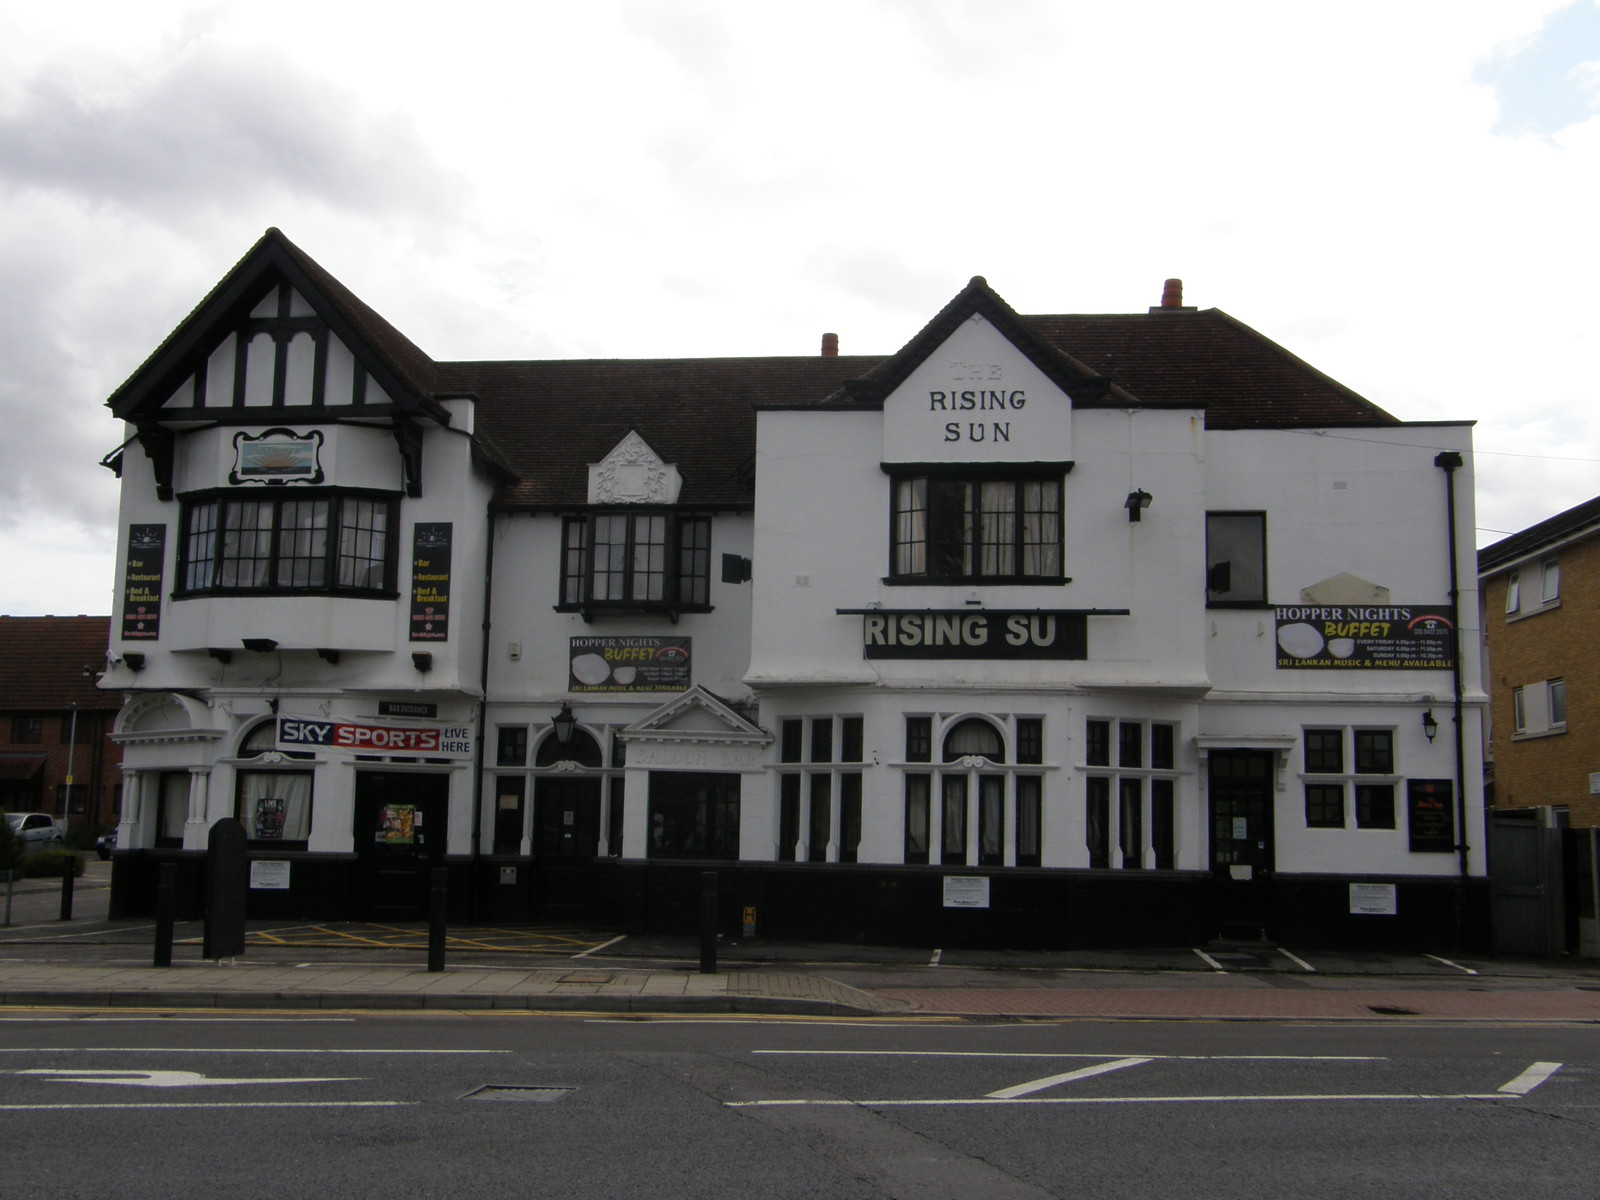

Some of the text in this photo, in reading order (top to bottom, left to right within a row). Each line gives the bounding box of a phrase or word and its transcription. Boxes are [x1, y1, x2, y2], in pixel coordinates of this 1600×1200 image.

[950, 361, 1002, 380] THE
[929, 390, 1026, 411] RISING
[944, 422, 1010, 442] SUN
[418, 559, 430, 567] Bar
[131, 573, 160, 581] Restaurant
[417, 573, 448, 581] Restaurant
[130, 587, 143, 595] Bed
[417, 587, 430, 595] Bed
[130, 594, 159, 602] Breakfast
[416, 594, 447, 602] Breakfast
[1276, 608, 1411, 620] HOPPER NIGHTS
[864, 615, 1056, 647] RISING SU
[1324, 622, 1391, 637] BUFFET
[572, 638, 661, 647] HOPPER NIGHTS
[603, 647, 655, 661] BUFFET
[389, 704, 428, 714] BAR ENTRANCE
[283, 722, 436, 748] SKY SPORTS
[444, 728, 468, 739] LIVE
[442, 741, 470, 753] HERE
[636, 747, 756, 768] SALOON BAR
[745, 909, 754, 921] H
